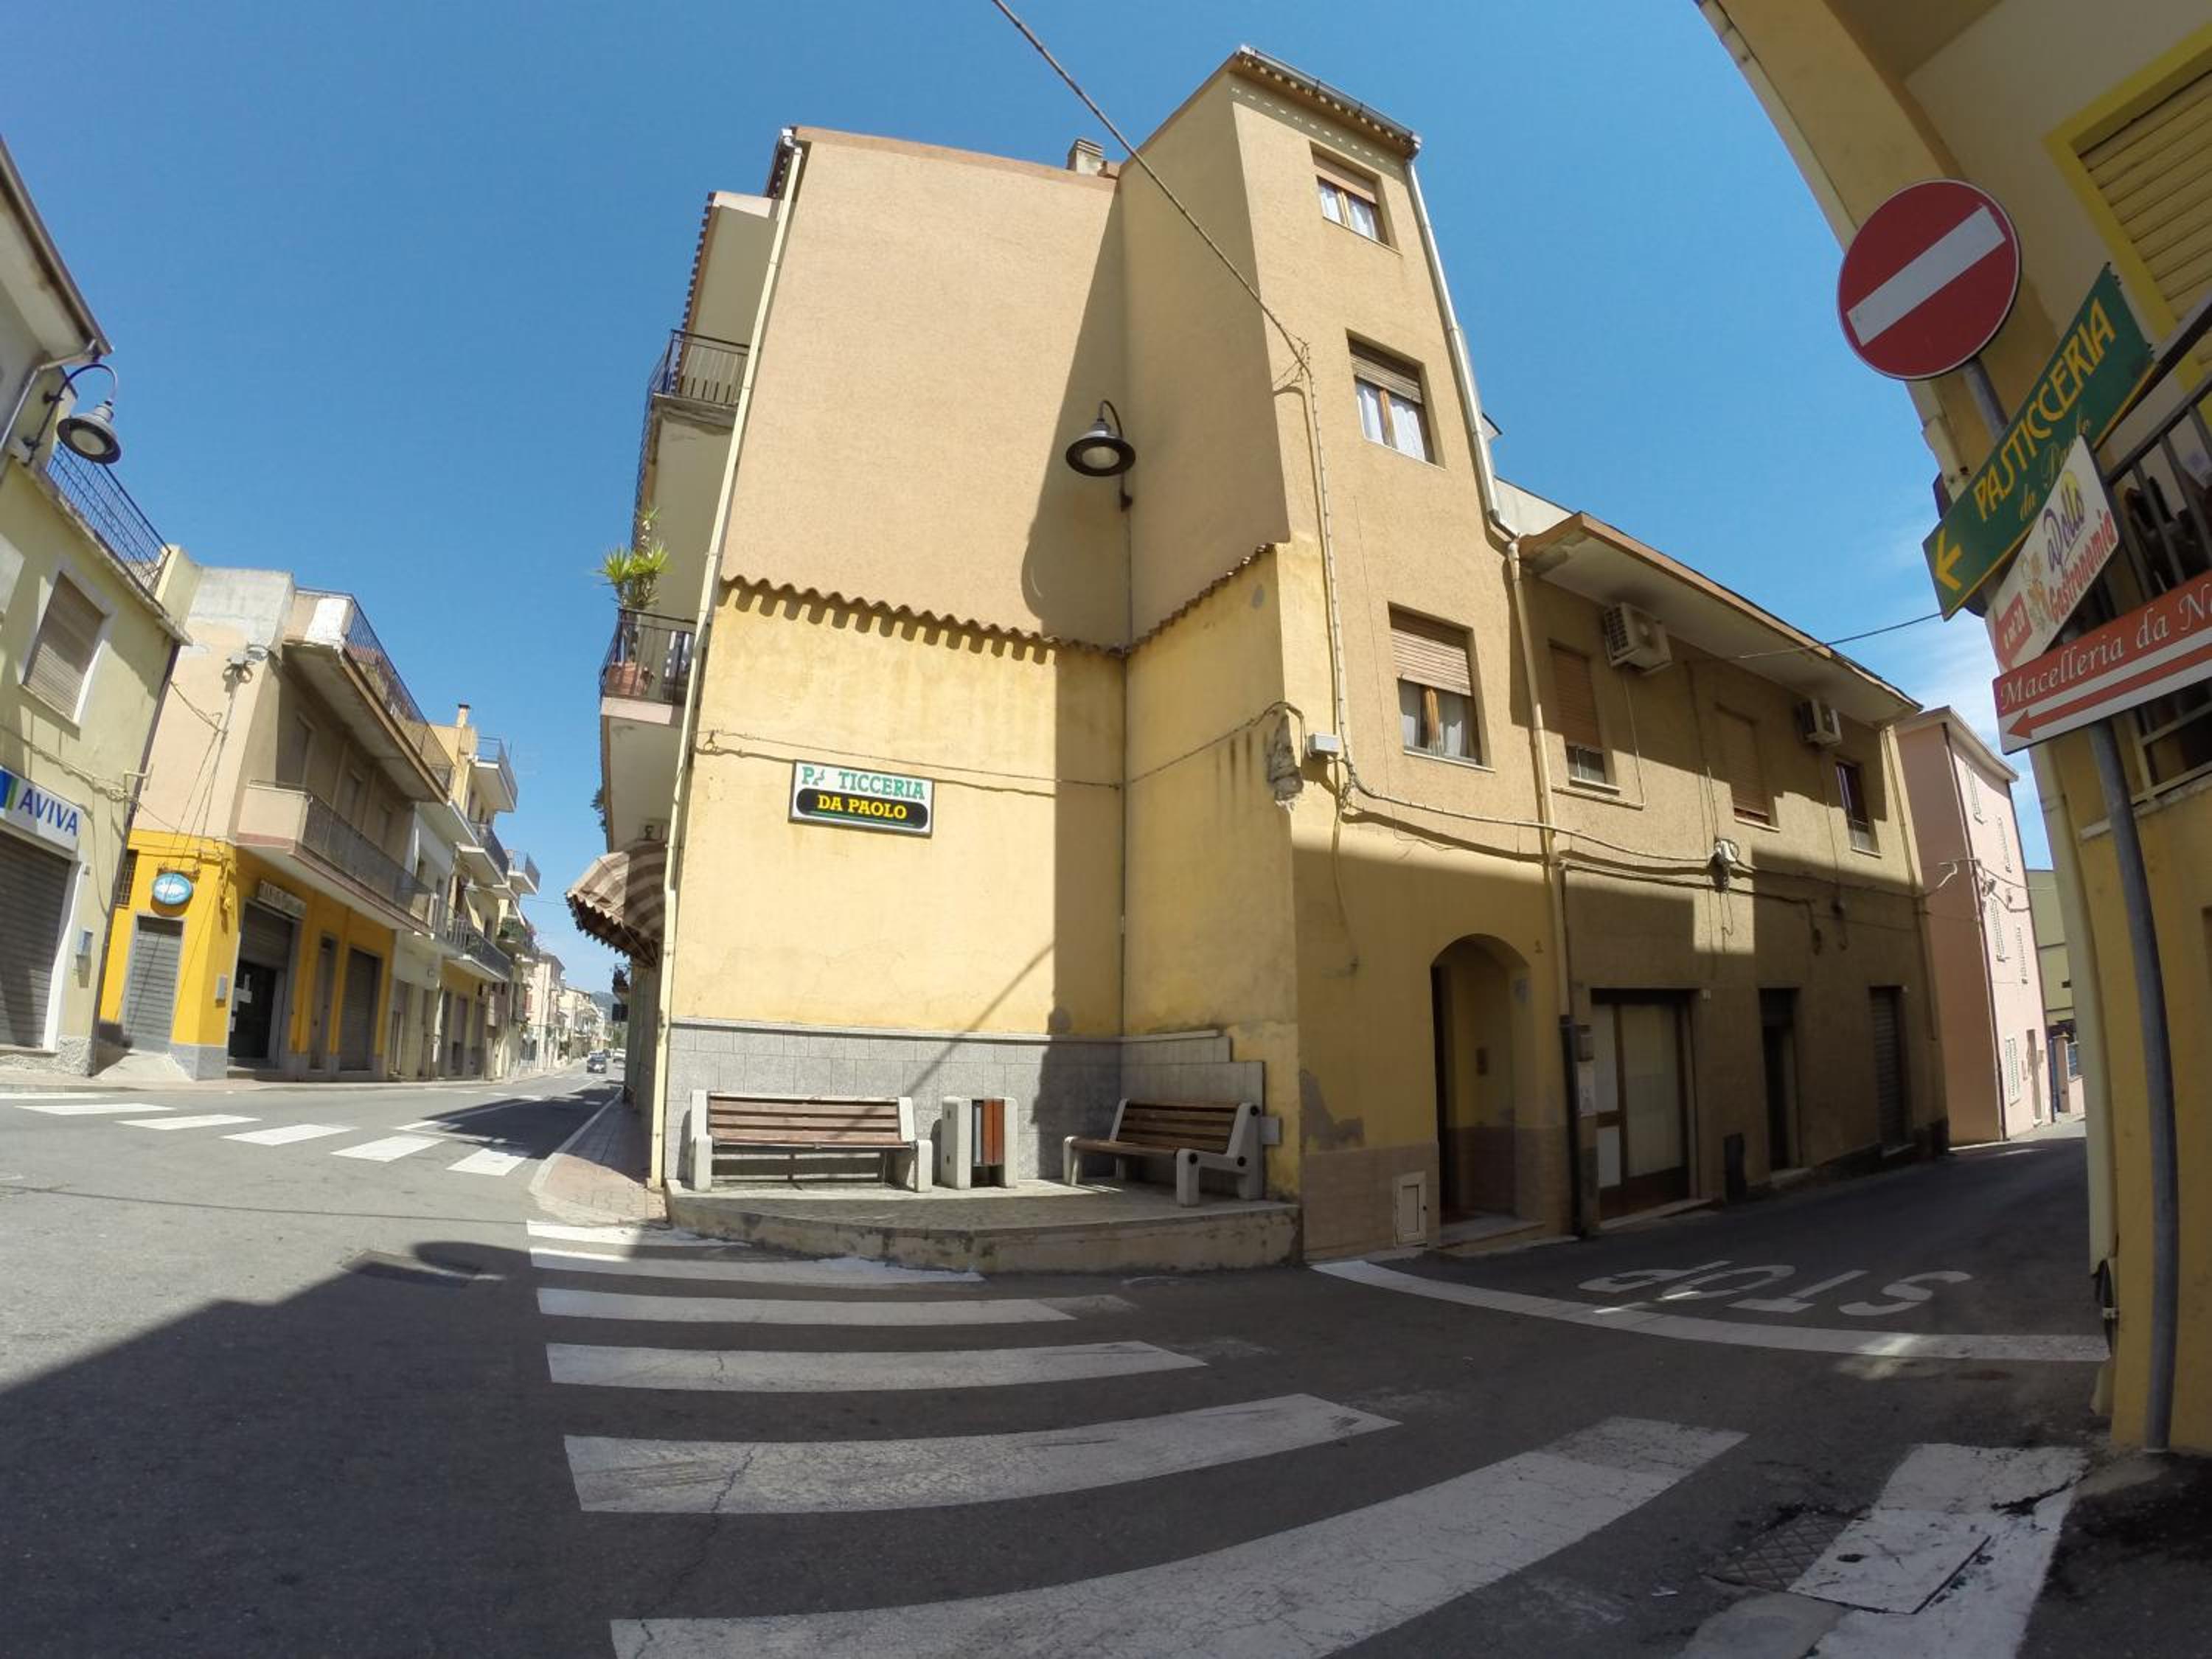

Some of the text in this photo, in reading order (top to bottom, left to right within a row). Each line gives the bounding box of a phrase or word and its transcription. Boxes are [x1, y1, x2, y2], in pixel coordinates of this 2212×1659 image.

[1973, 297, 2115, 520] PASTICCERIA
[2000, 634, 2125, 710] Macelleria
[2135, 608, 2171, 650] da
[18, 787, 77, 837] AVIVA
[817, 793, 908, 820] DA PAOLO
[1577, 1259, 1972, 1317] STOP
